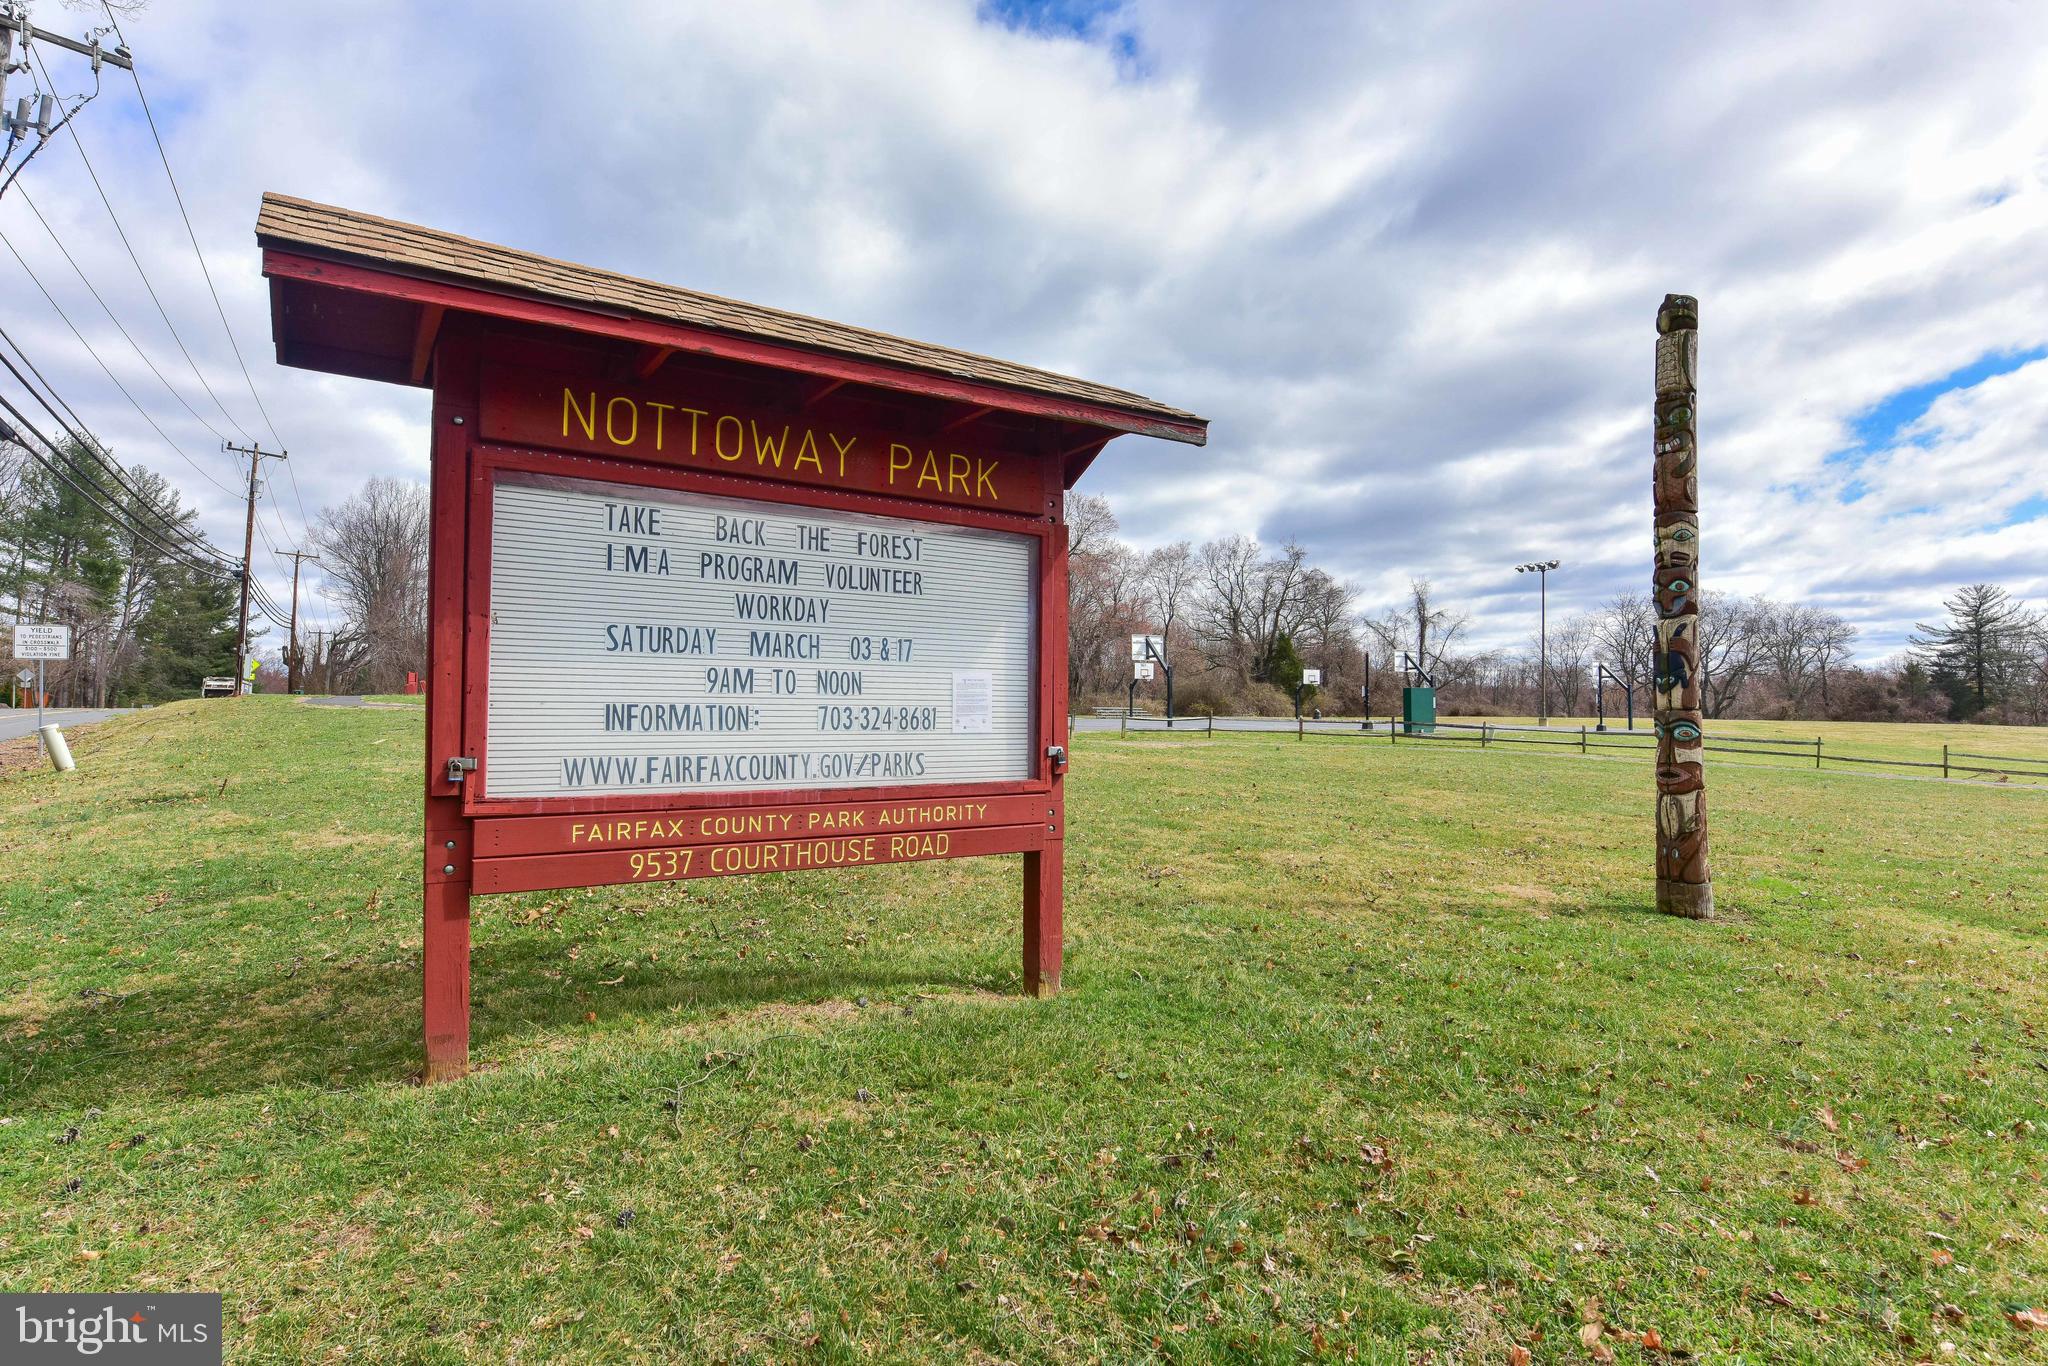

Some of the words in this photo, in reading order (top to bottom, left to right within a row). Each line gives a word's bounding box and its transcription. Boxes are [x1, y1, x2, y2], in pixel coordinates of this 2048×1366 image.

[562, 387, 857, 478] NOTTOWAY
[889, 444, 1000, 501] PARK
[605, 503, 661, 536] TAKE
[715, 515, 767, 547] BACK
[797, 524, 831, 553] THE
[857, 531, 923, 561] FOREST
[701, 552, 799, 586] PROGRAM
[825, 563, 923, 595] VOLUNTEER
[735, 593, 830, 624] WORKDAY
[606, 624, 717, 655] SATURDAY
[750, 631, 820, 660] MARCH
[706, 667, 754, 694] 9AM
[772, 669, 797, 694] TO
[817, 670, 862, 695] NOON
[605, 703, 760, 731] INFORMATION:
[818, 705, 937, 731] 703-324-8681
[563, 752, 926, 786] WWW.FAIRFAXCOUNTY.GOV/PARKS
[571, 819, 684, 844] FAIRFAX
[700, 813, 793, 837] COUNTY
[808, 810, 865, 830] PARK
[879, 803, 988, 825] AUTHORITY
[629, 849, 693, 879] 9537
[710, 837, 876, 873] COURTHOUSE
[890, 833, 950, 858] ROAD
